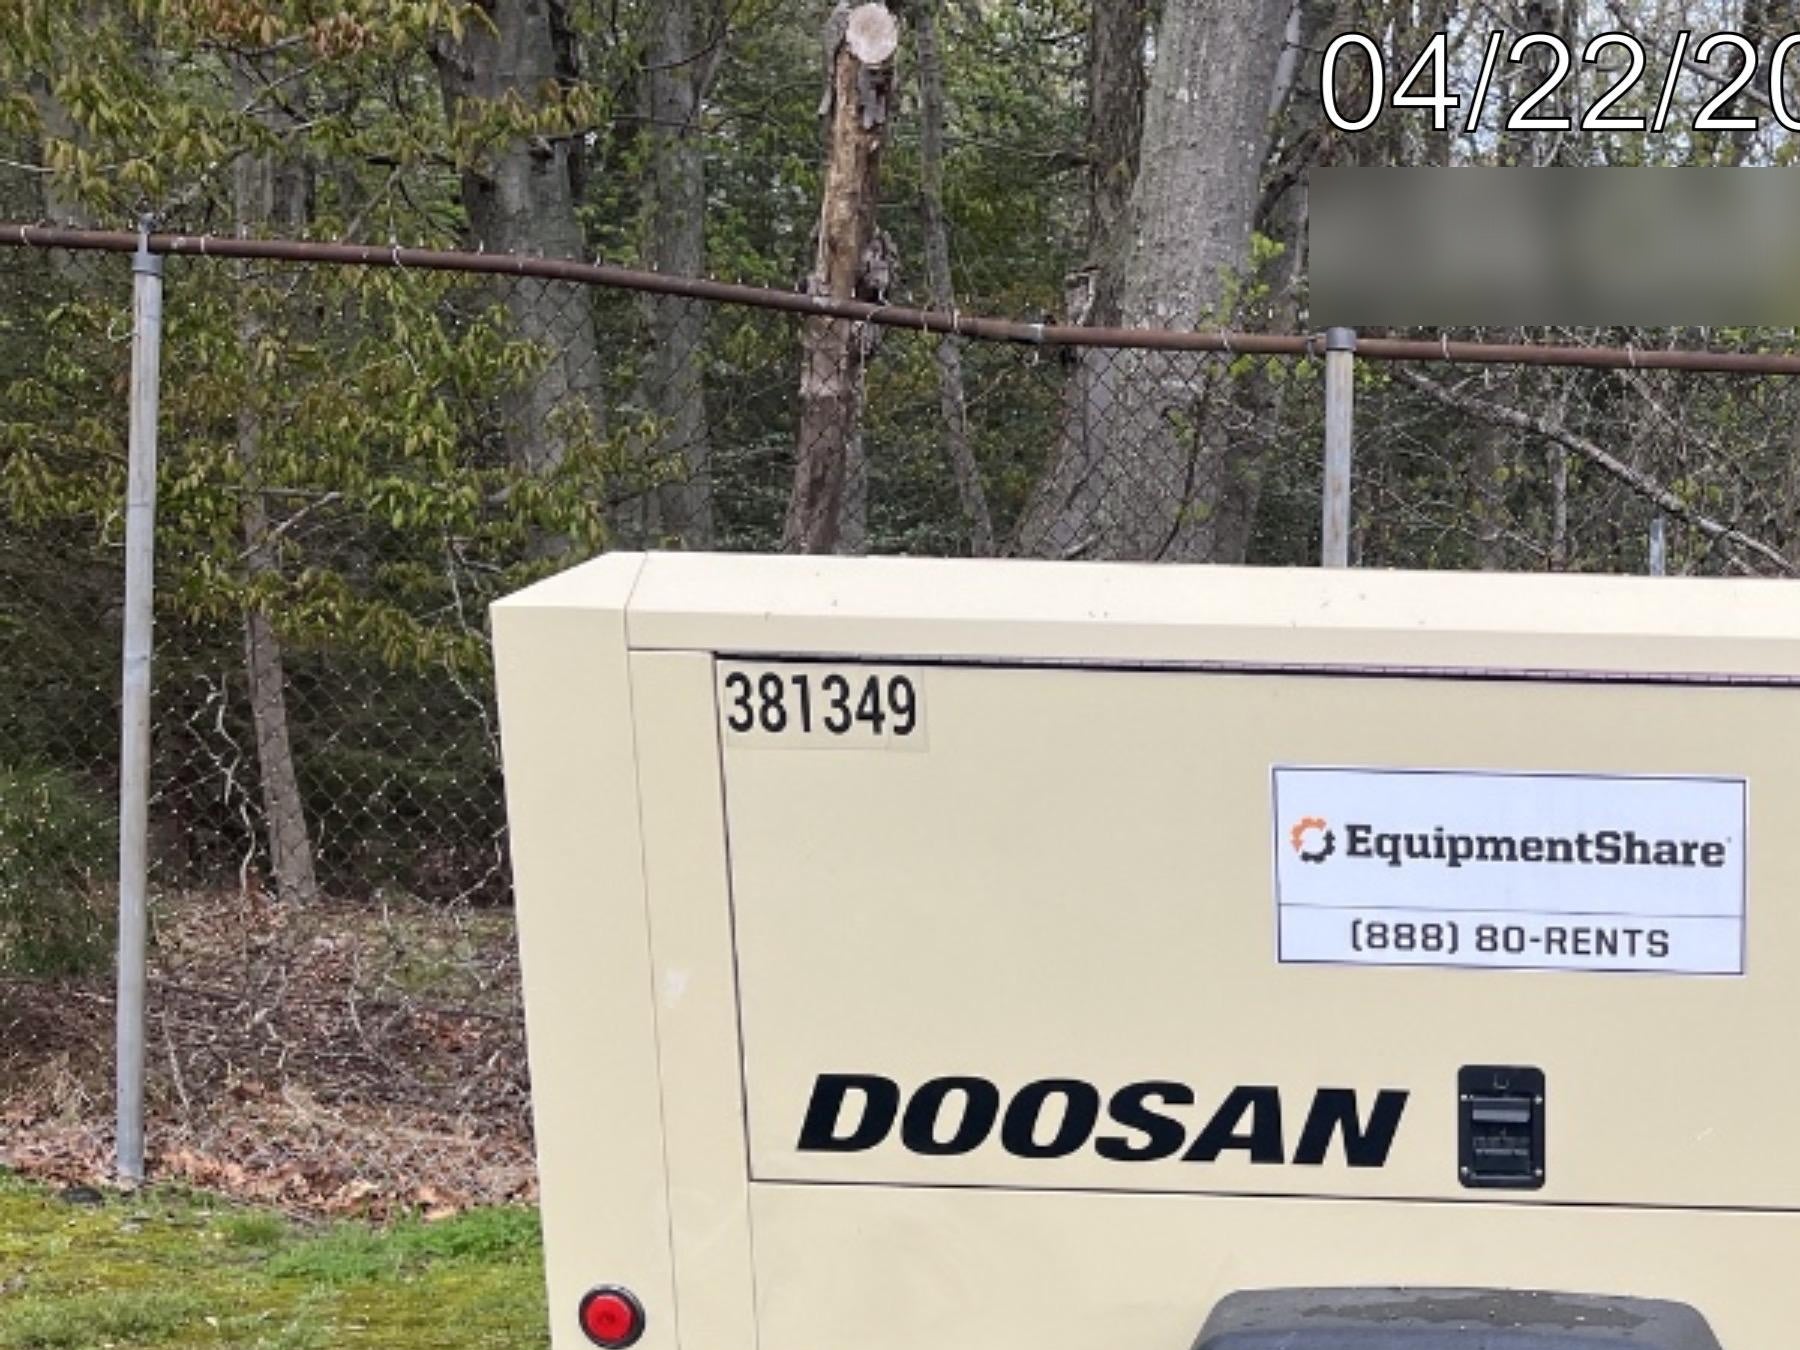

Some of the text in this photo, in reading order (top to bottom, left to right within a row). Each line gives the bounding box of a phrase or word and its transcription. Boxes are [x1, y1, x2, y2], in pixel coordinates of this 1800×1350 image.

[725, 672, 917, 736] 381349
[1345, 823, 1726, 868] EquipmentShare
[1351, 919, 1670, 958] (888) 80-RENTS
[797, 1073, 1409, 1168] DOOSAN
